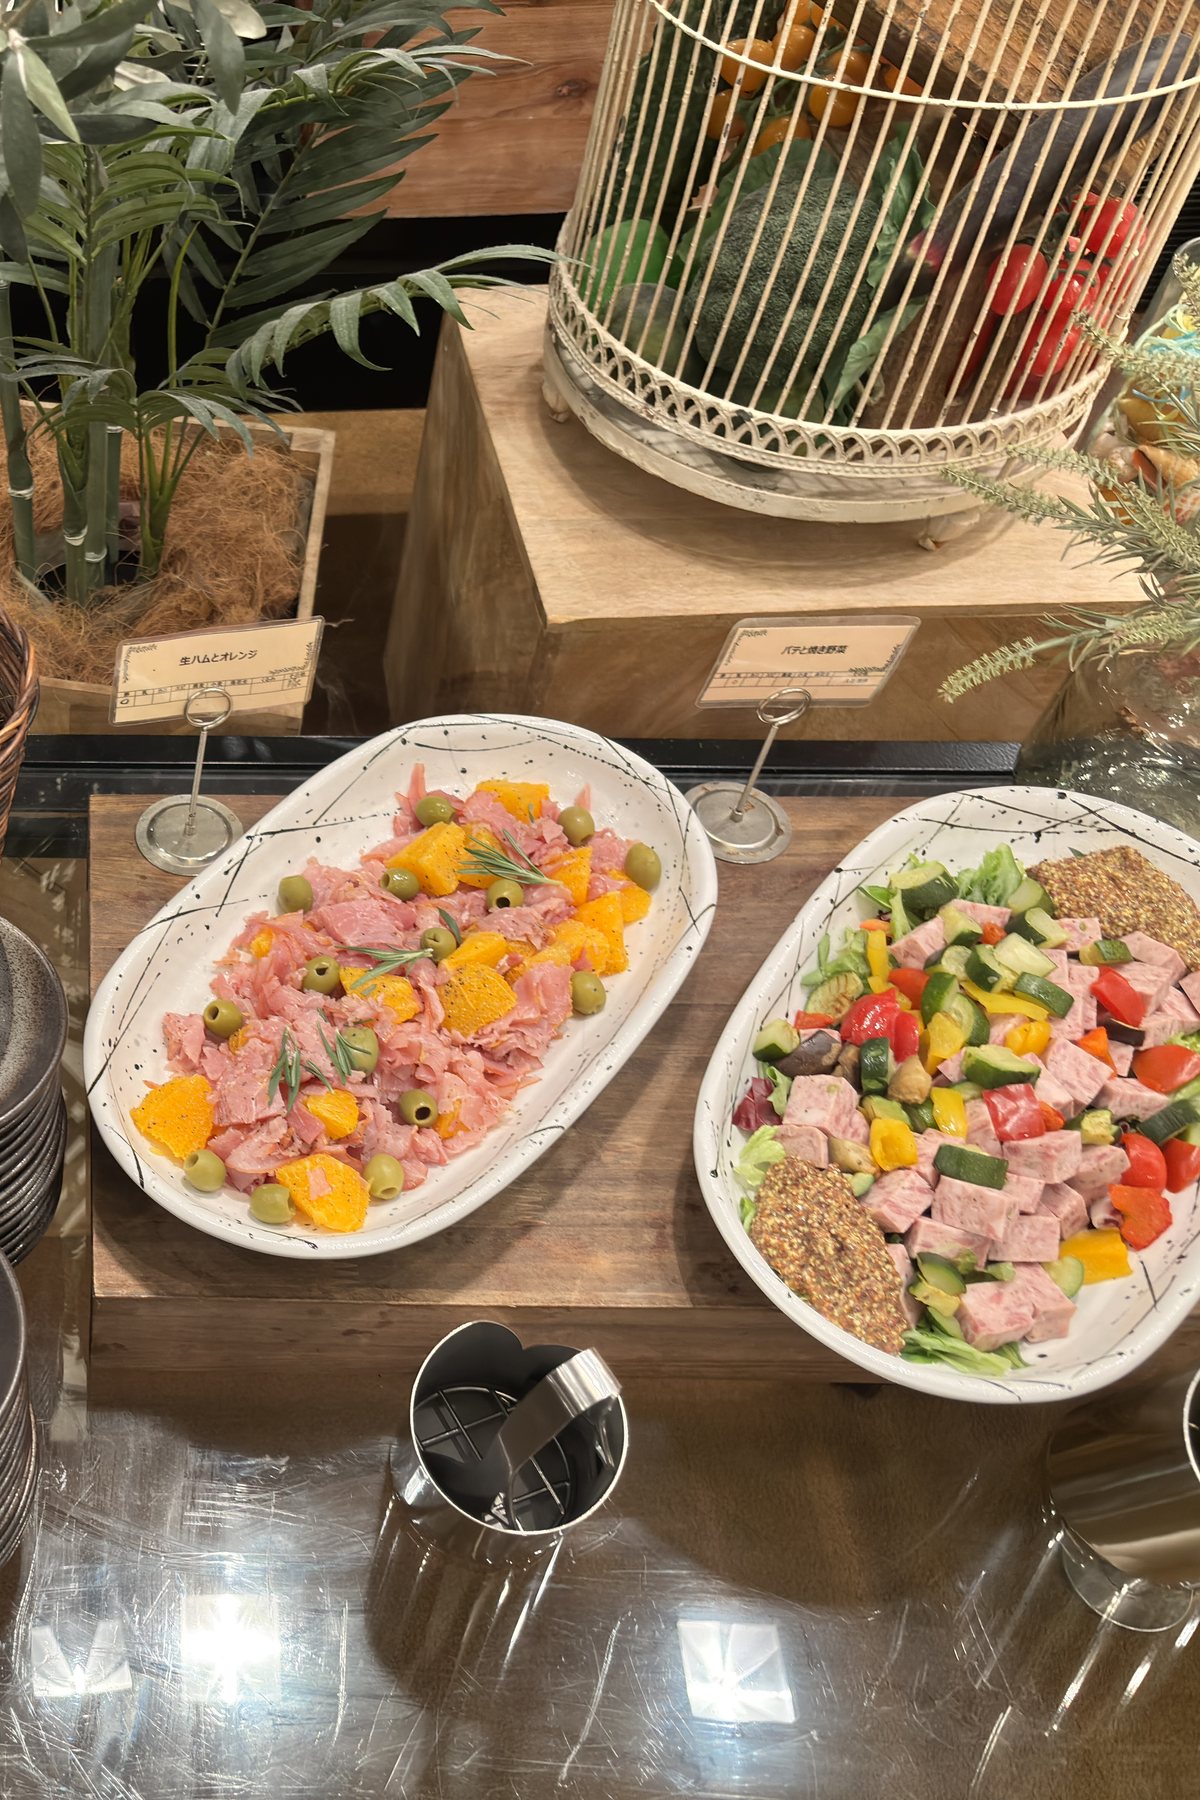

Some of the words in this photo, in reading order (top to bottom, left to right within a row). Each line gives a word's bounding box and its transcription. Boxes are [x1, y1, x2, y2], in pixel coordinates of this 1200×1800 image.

[179, 650, 257, 666] 生ハムとオレンジ
